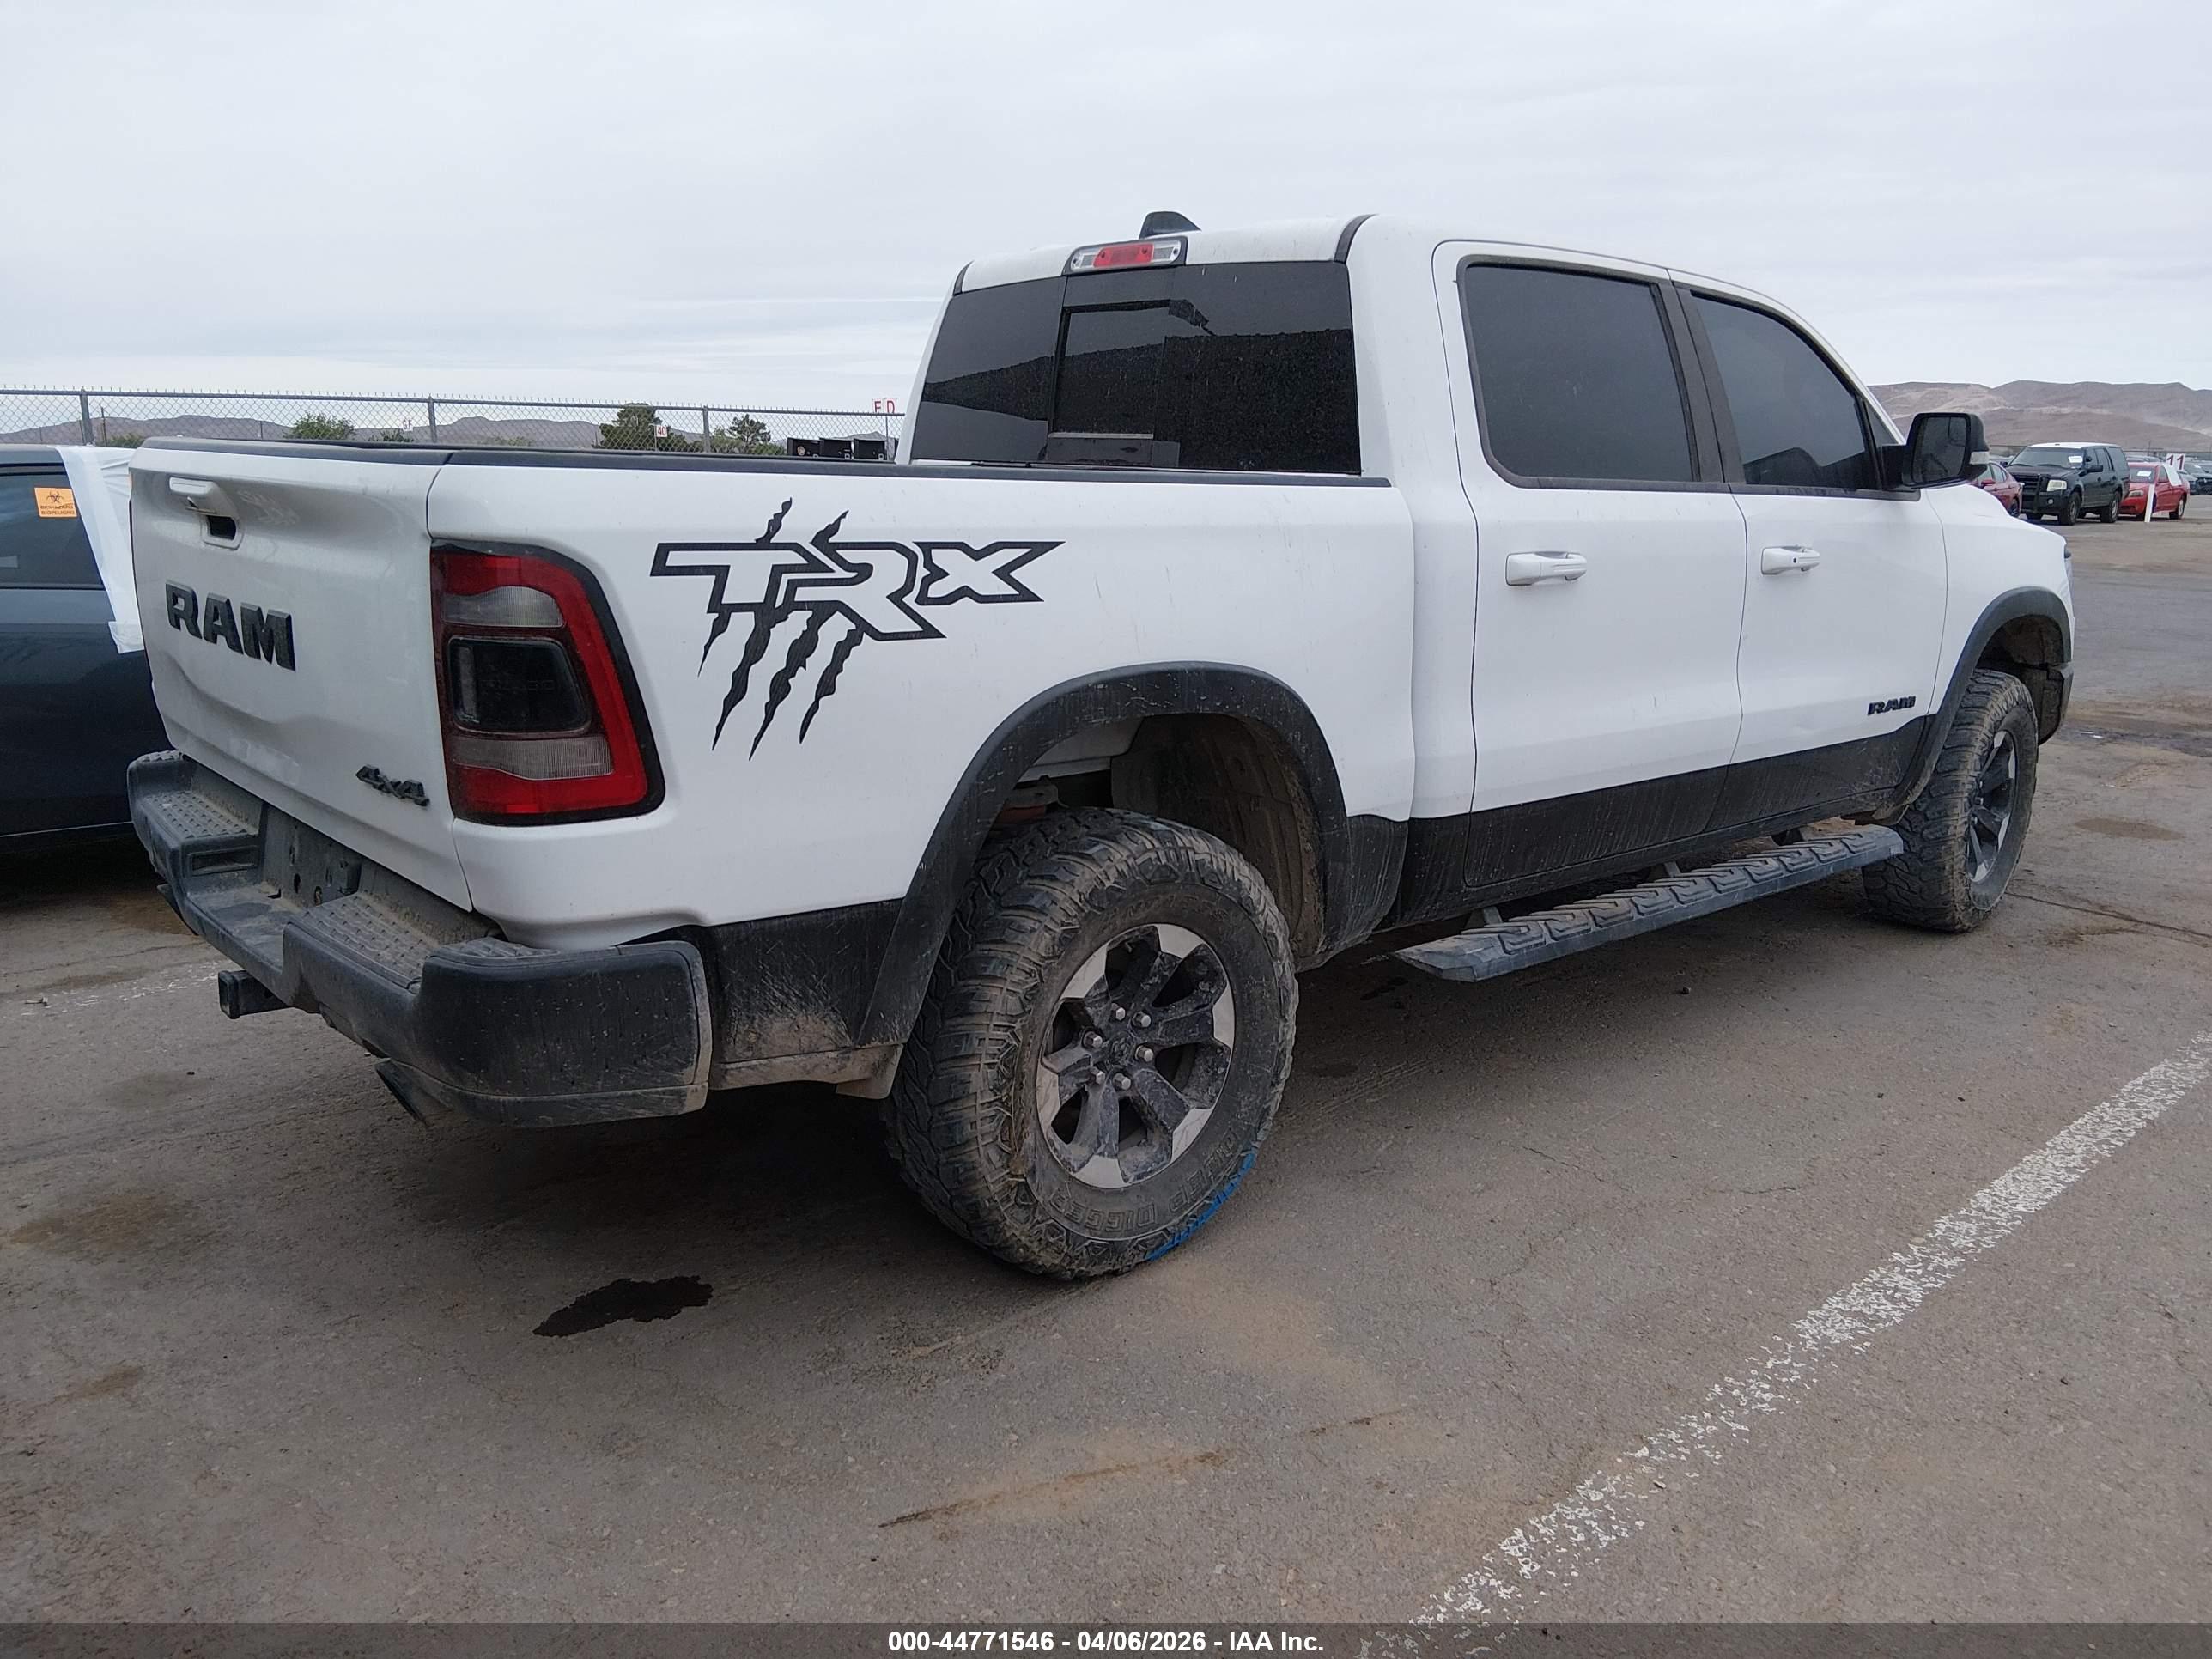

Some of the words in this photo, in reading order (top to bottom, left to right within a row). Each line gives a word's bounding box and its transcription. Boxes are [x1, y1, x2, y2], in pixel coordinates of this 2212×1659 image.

[165, 580, 295, 672] RAM
[650, 540, 1066, 642] TRX
[1867, 695, 1917, 716] RAM
